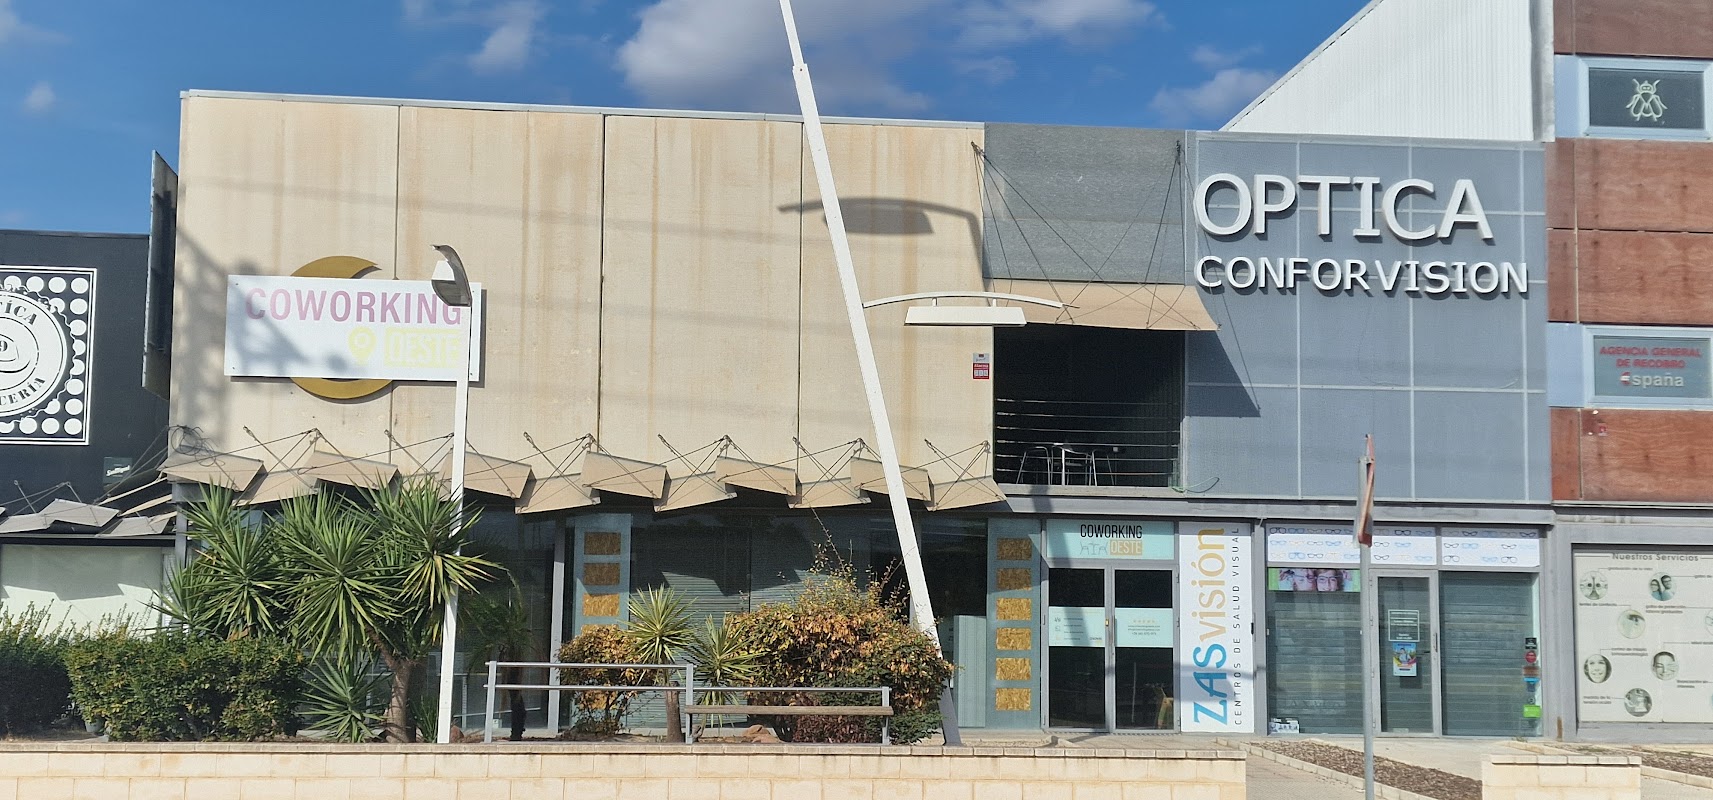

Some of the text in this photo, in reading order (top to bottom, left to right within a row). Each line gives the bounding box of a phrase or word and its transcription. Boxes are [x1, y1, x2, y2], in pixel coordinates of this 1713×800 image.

[1194, 173, 1494, 240] OPTICA
[0, 300, 37, 326] ÍCA
[245, 287, 461, 325] COWORKING
[388, 331, 461, 365] OESTE
[1600, 347, 1701, 357] AGENCIA GENERAL
[1616, 359, 1685, 368] DE RECOBRO
[1080, 524, 1143, 539] COWORKING
[1111, 540, 1142, 554] OESTE
[1612, 552, 1699, 562] Nuestros Servicios
[1231, 528, 1242, 726] CENTROS DE SALUD VISUAL
